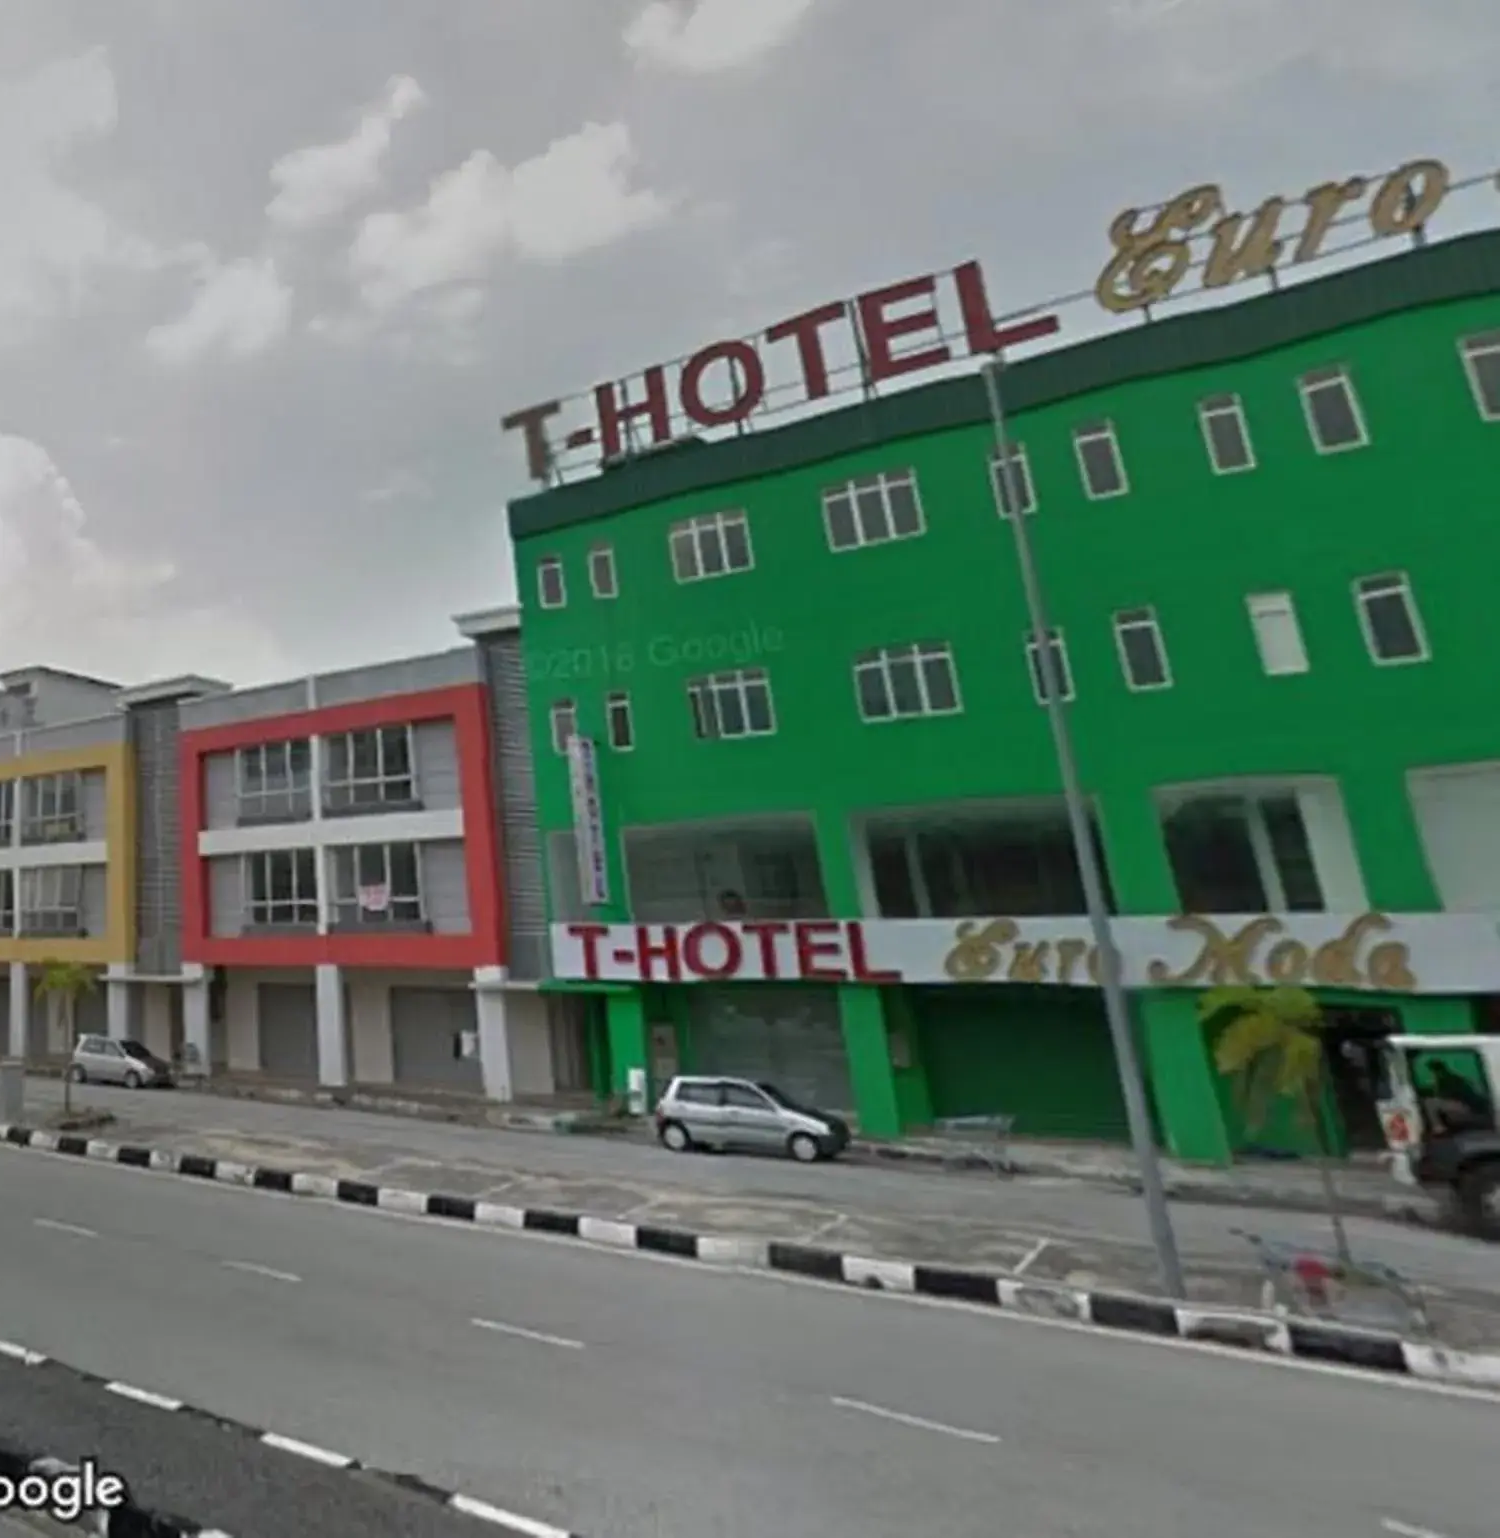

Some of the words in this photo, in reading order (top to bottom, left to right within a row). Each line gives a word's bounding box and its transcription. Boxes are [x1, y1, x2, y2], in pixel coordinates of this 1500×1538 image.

[501, 259, 1060, 481] T-HOTEL
[1094, 158, 1450, 314] Euro
[566, 920, 904, 984] T-HOTEL
[1147, 910, 1418, 992] Moda
